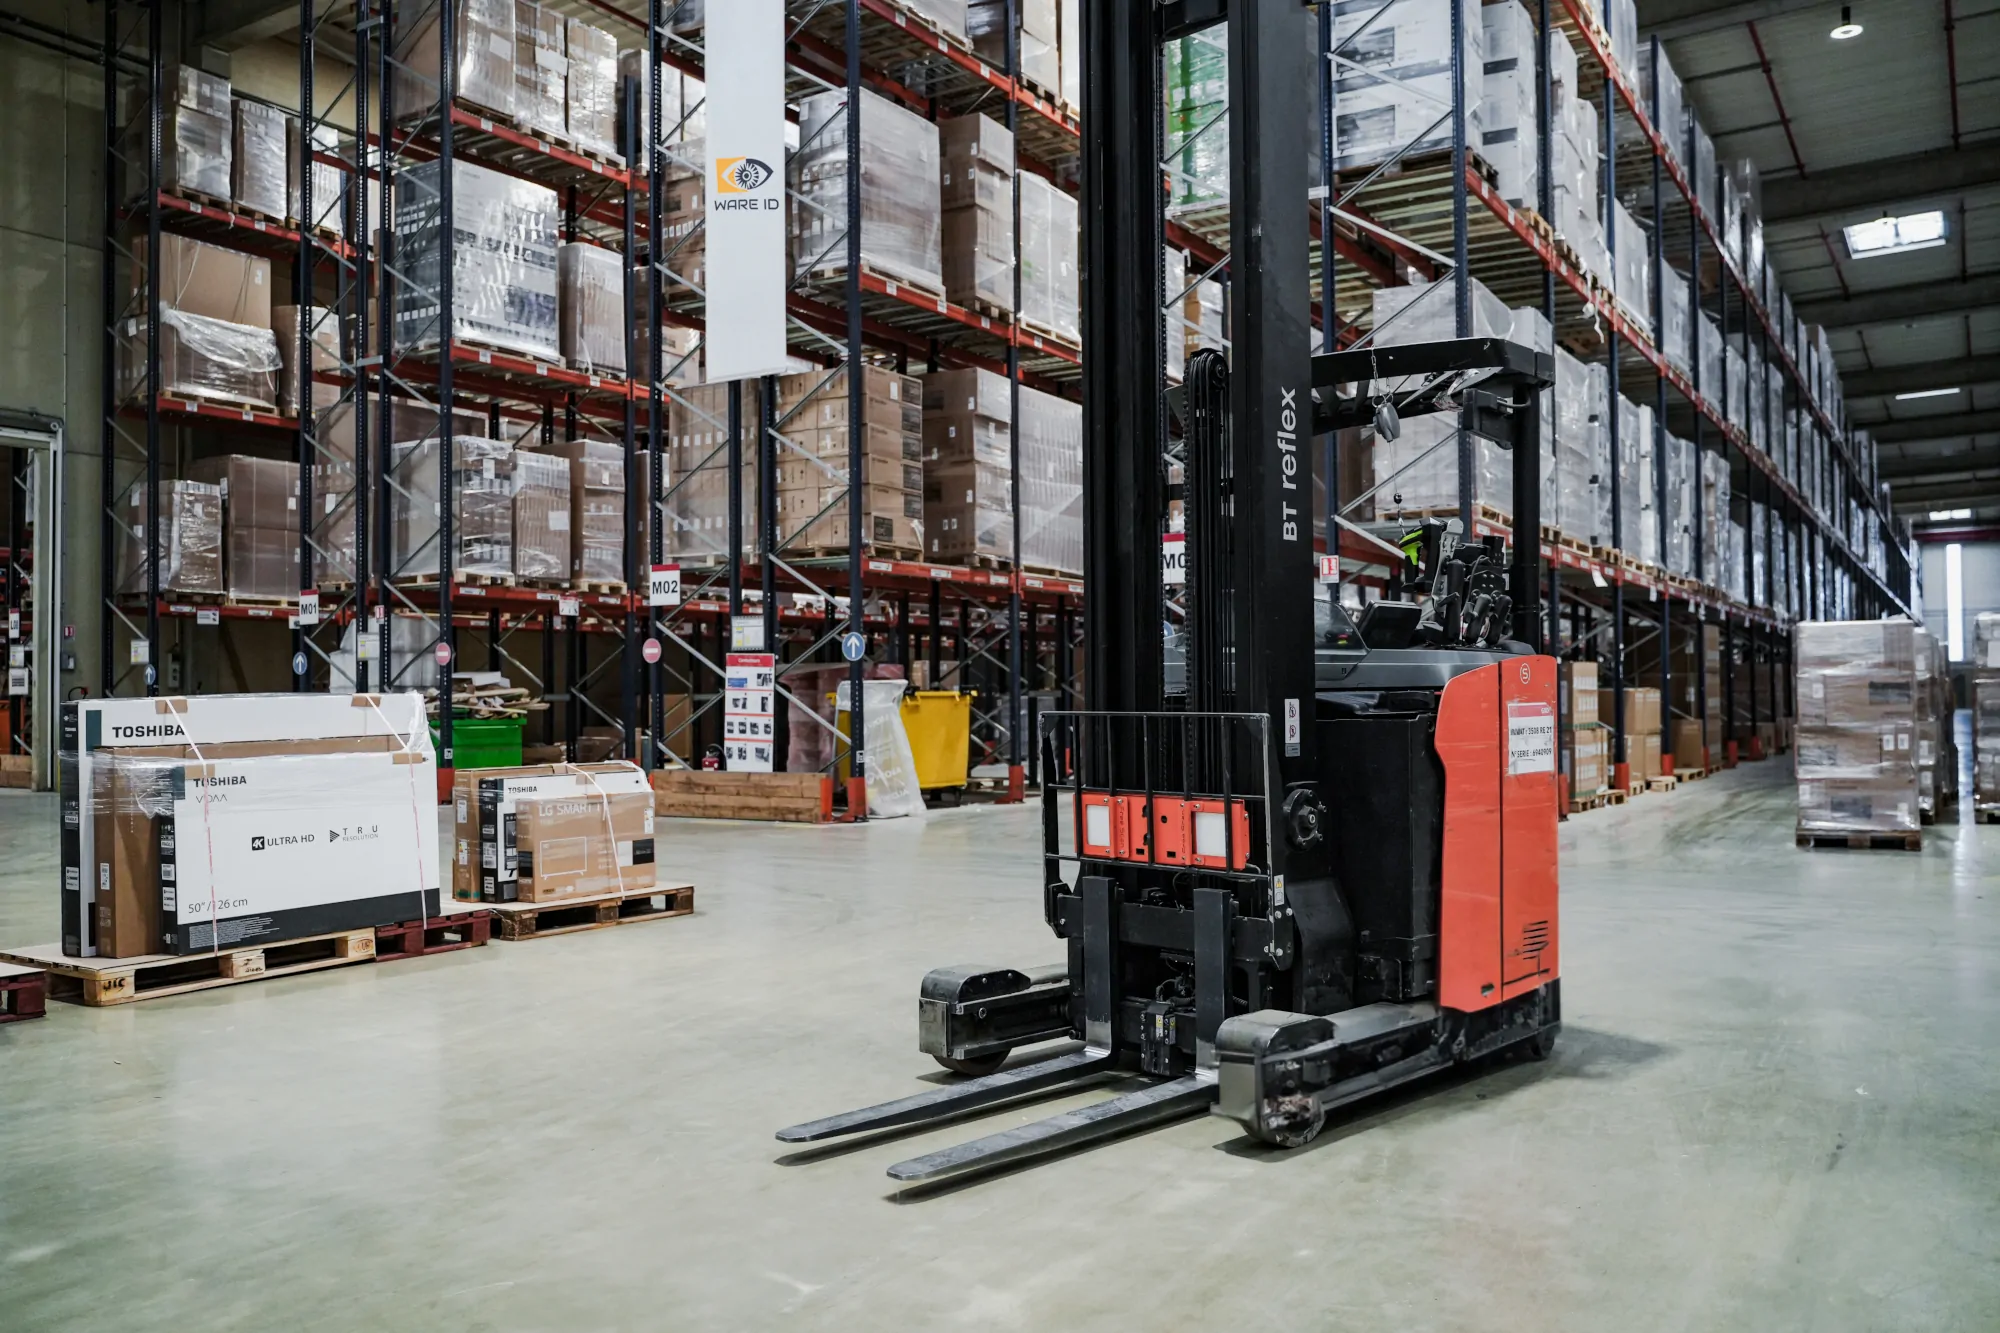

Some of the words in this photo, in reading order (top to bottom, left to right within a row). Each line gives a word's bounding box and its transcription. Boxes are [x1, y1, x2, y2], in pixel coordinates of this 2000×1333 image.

[714, 198, 759, 211] WARE
[763, 198, 779, 210] ID
[1277, 386, 1297, 490] reflex
[1283, 501, 1298, 541] BT
[1163, 552, 1186, 569] M0
[652, 580, 678, 595] M02
[300, 602, 318, 616] M01
[112, 724, 185, 738] TOSHIBA
[1517, 749, 1529, 758] SERIE
[193, 775, 247, 788] TOSHIBA
[508, 785, 538, 795] TOSHIBA
[538, 804, 553, 817] LG
[556, 803, 591, 816] SMART
[252, 837, 265, 850] 4K
[267, 836, 298, 847] ULTRA
[300, 834, 315, 843] HD
[342, 833, 379, 842] RESOLUTION
[232, 898, 248, 908] cm
